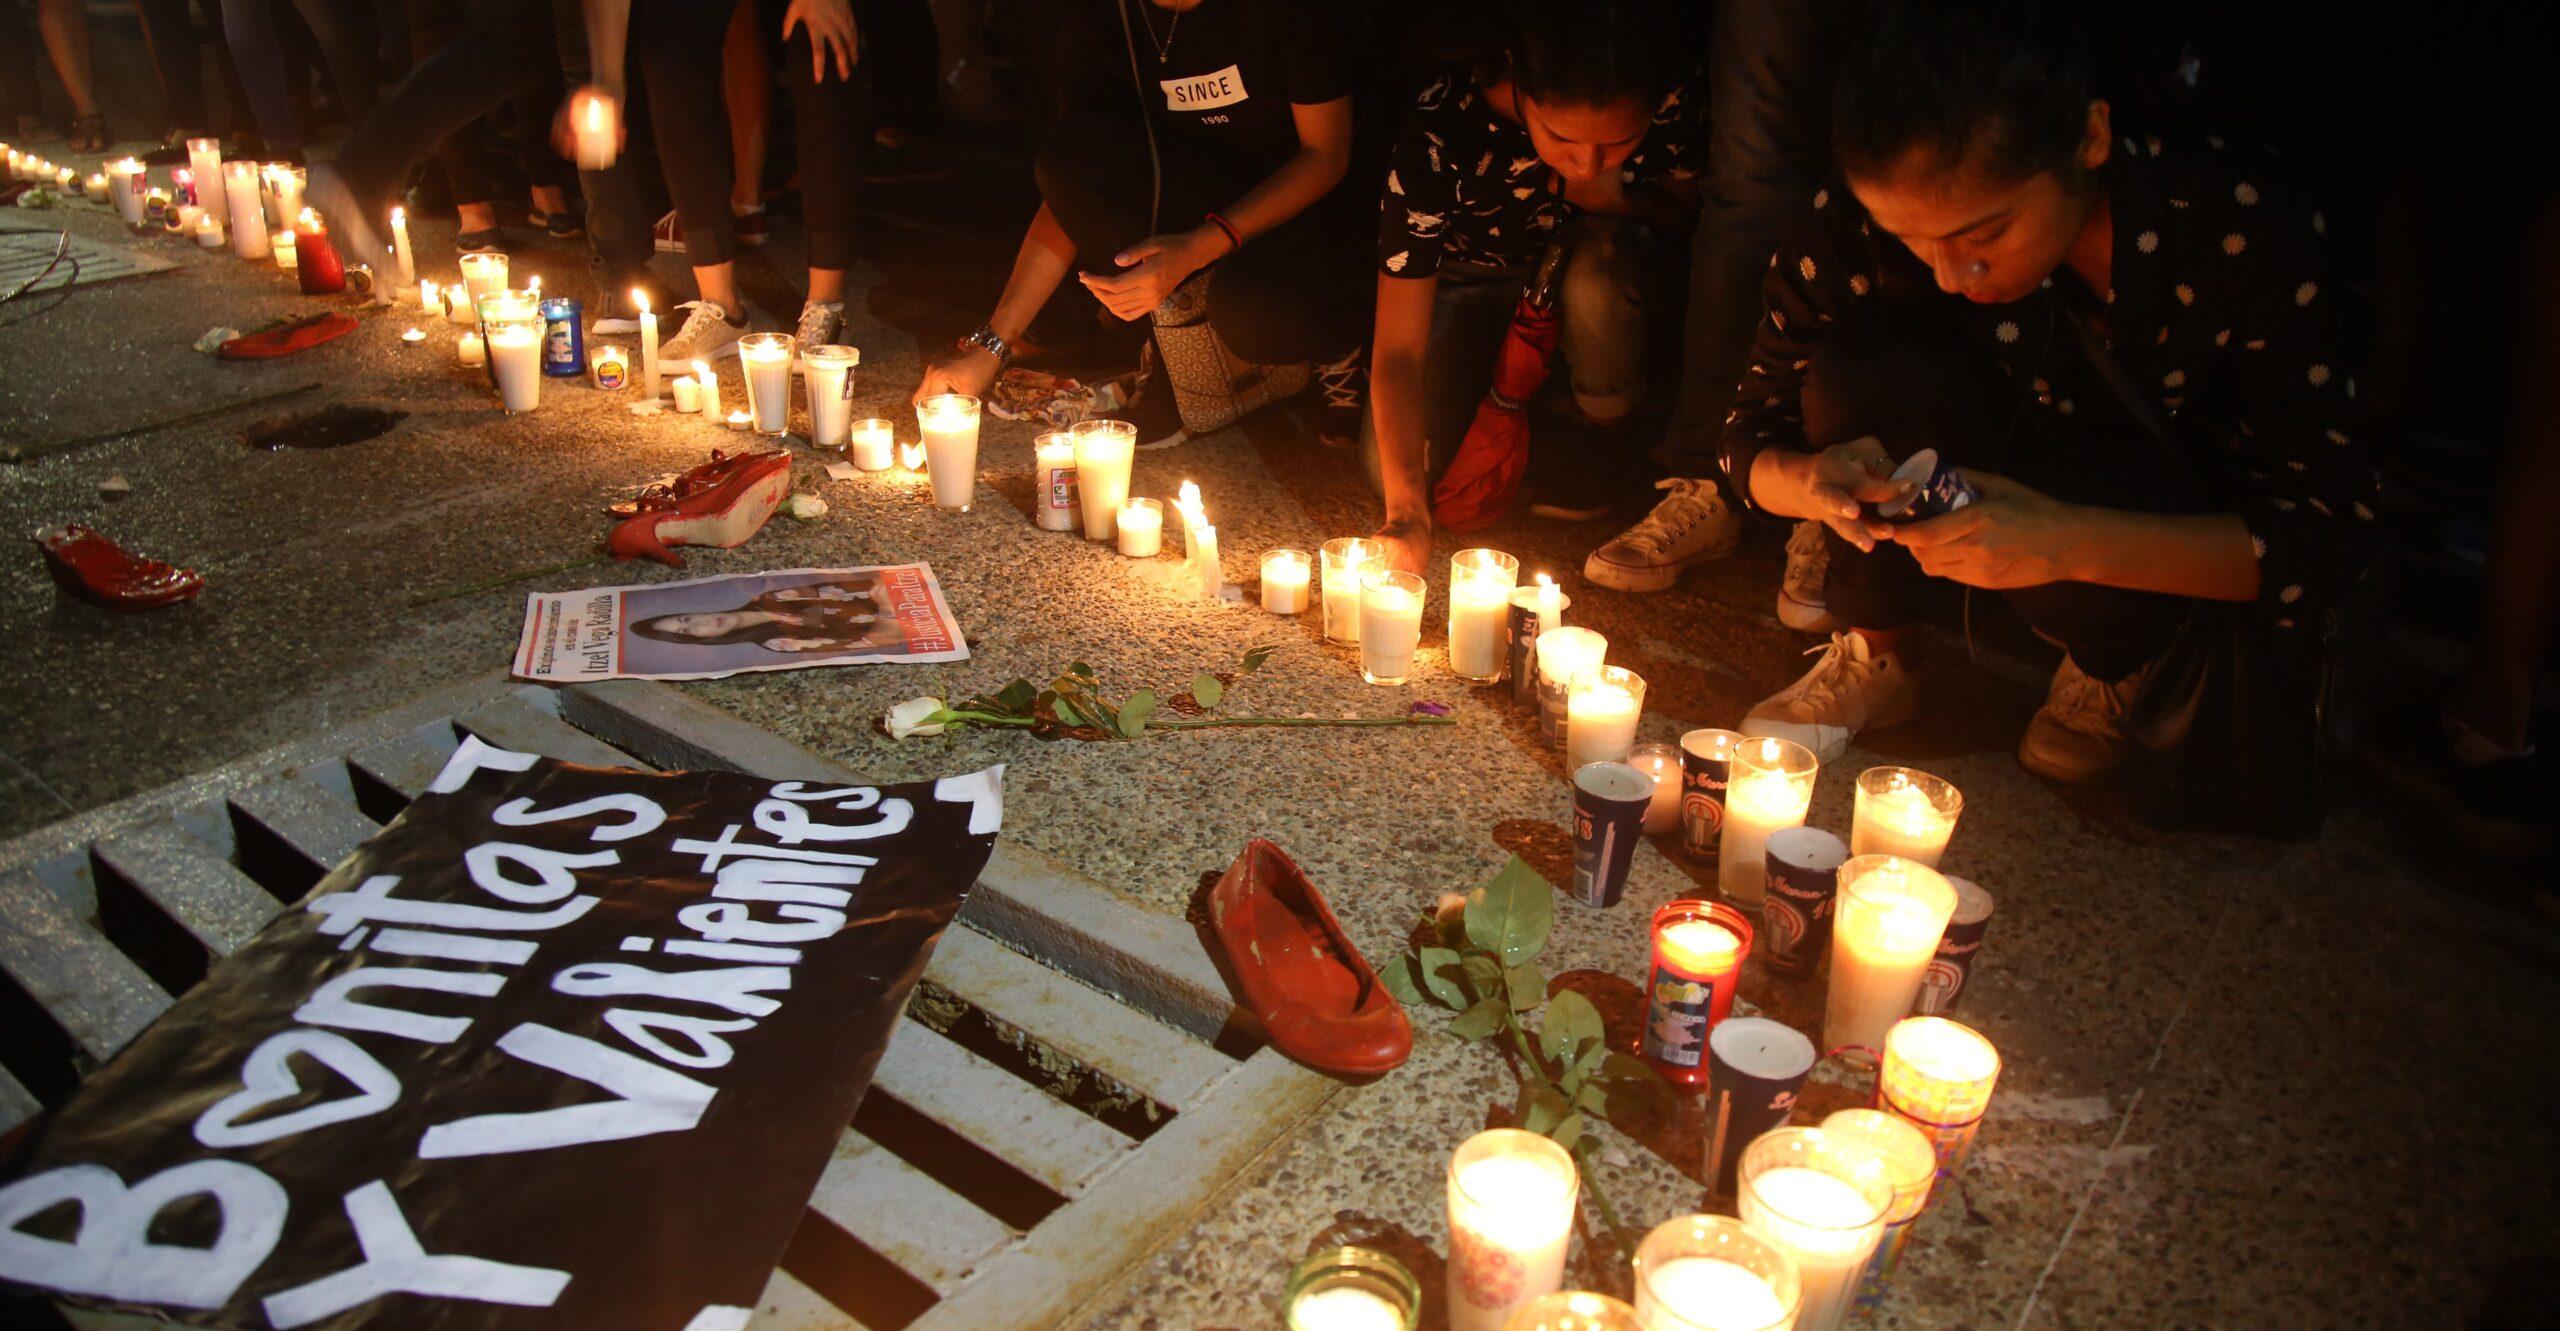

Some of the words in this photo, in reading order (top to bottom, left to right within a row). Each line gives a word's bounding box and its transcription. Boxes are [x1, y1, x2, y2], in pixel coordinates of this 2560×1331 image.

[1175, 76, 1232, 103] SINCE
[1201, 114, 1229, 125] 1990
[585, 594, 613, 627] Radilla
[885, 569, 949, 651] #JusticiaParaItzel
[583, 627, 619, 650] Vega
[581, 651, 609, 673] Itzel
[418, 780, 914, 1159] Valientes
